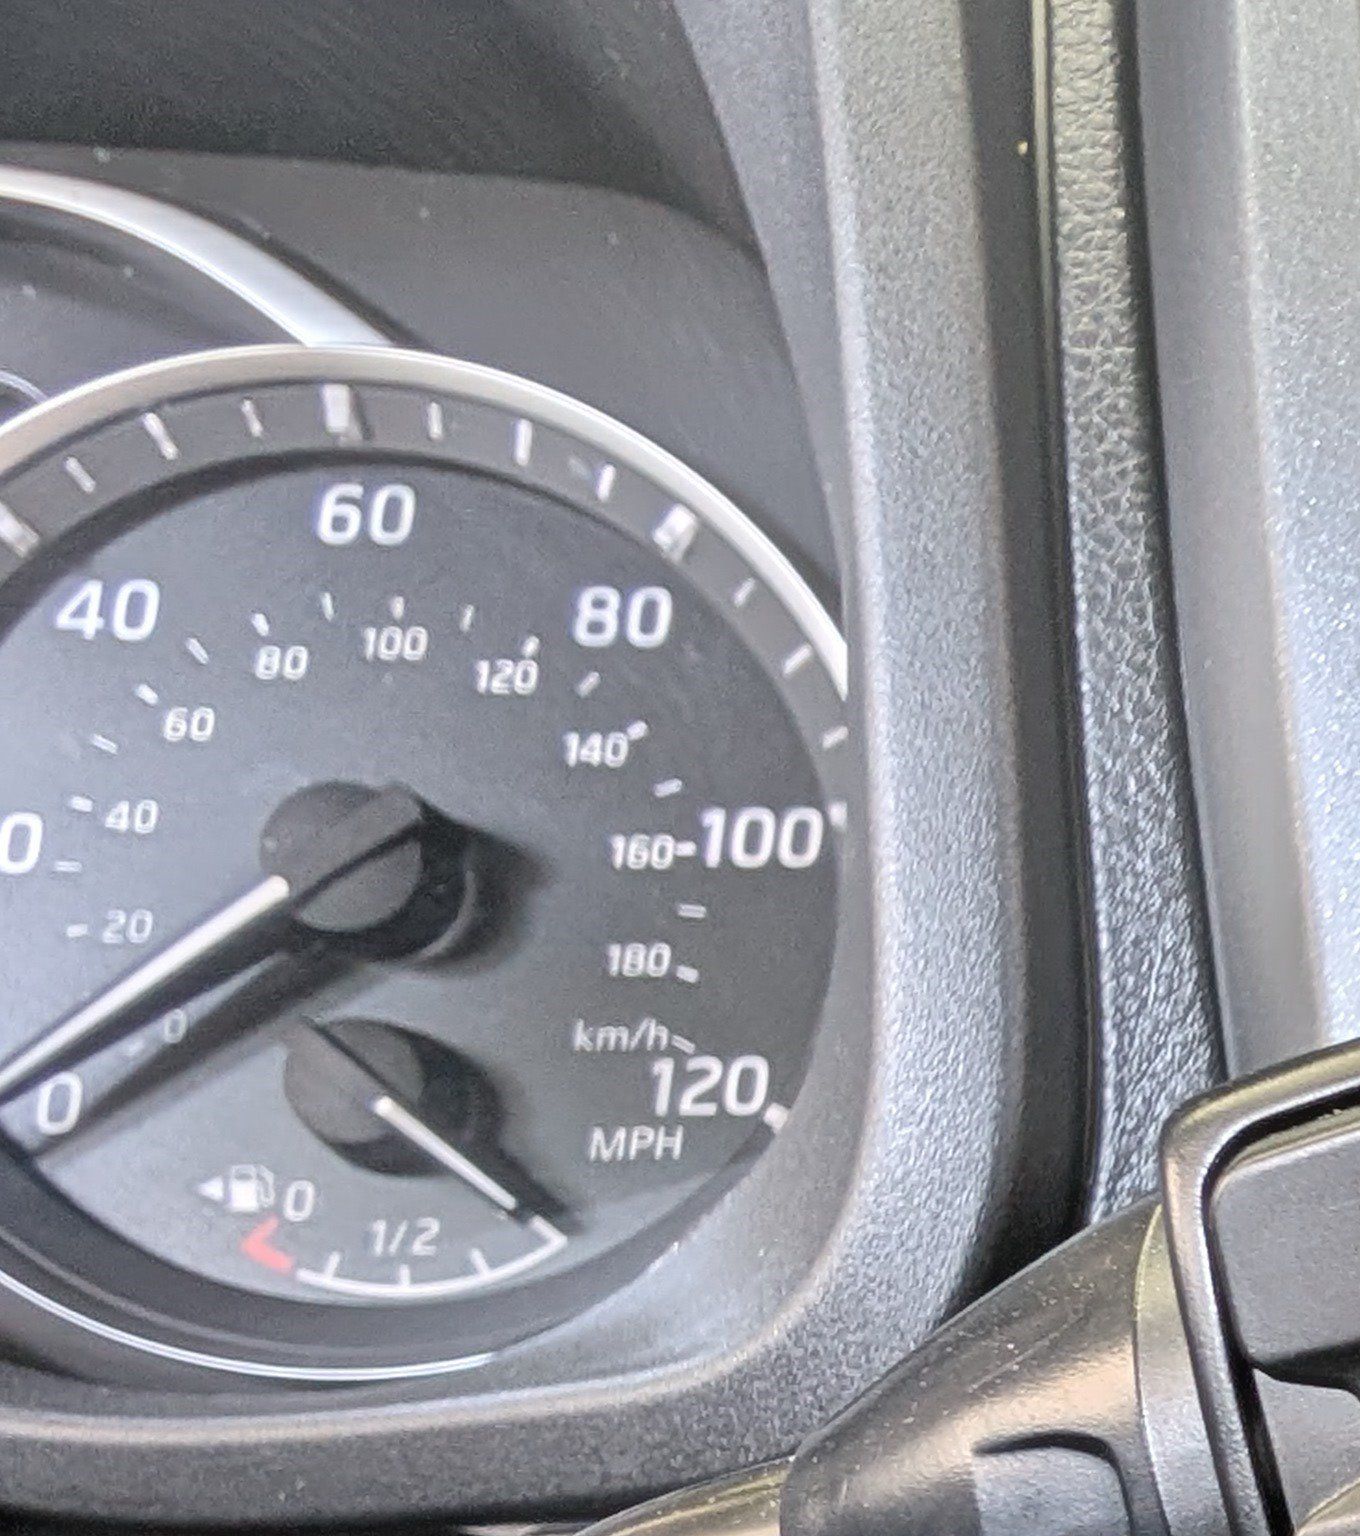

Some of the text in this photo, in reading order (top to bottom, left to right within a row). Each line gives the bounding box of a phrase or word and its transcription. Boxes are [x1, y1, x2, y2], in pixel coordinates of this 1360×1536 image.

[316, 484, 416, 545] 60
[55, 579, 160, 642] 40
[572, 586, 672, 648] 80
[364, 627, 428, 661] 100
[255, 645, 309, 681] 80
[475, 660, 538, 694] 120
[163, 707, 214, 743] 60
[564, 733, 628, 768] 140
[105, 799, 159, 834] 40
[611, 836, 674, 869] 160
[699, 808, 823, 868] 100
[102, 909, 153, 943] 20
[607, 945, 670, 976] 180
[163, 1008, 188, 1043] 0
[572, 1019, 668, 1053] km/h
[37, 1071, 83, 1135] 0
[650, 1054, 768, 1117] 120
[588, 1125, 684, 1162] MPH
[284, 1180, 315, 1222] 0
[370, 1217, 441, 1257] 1/2
